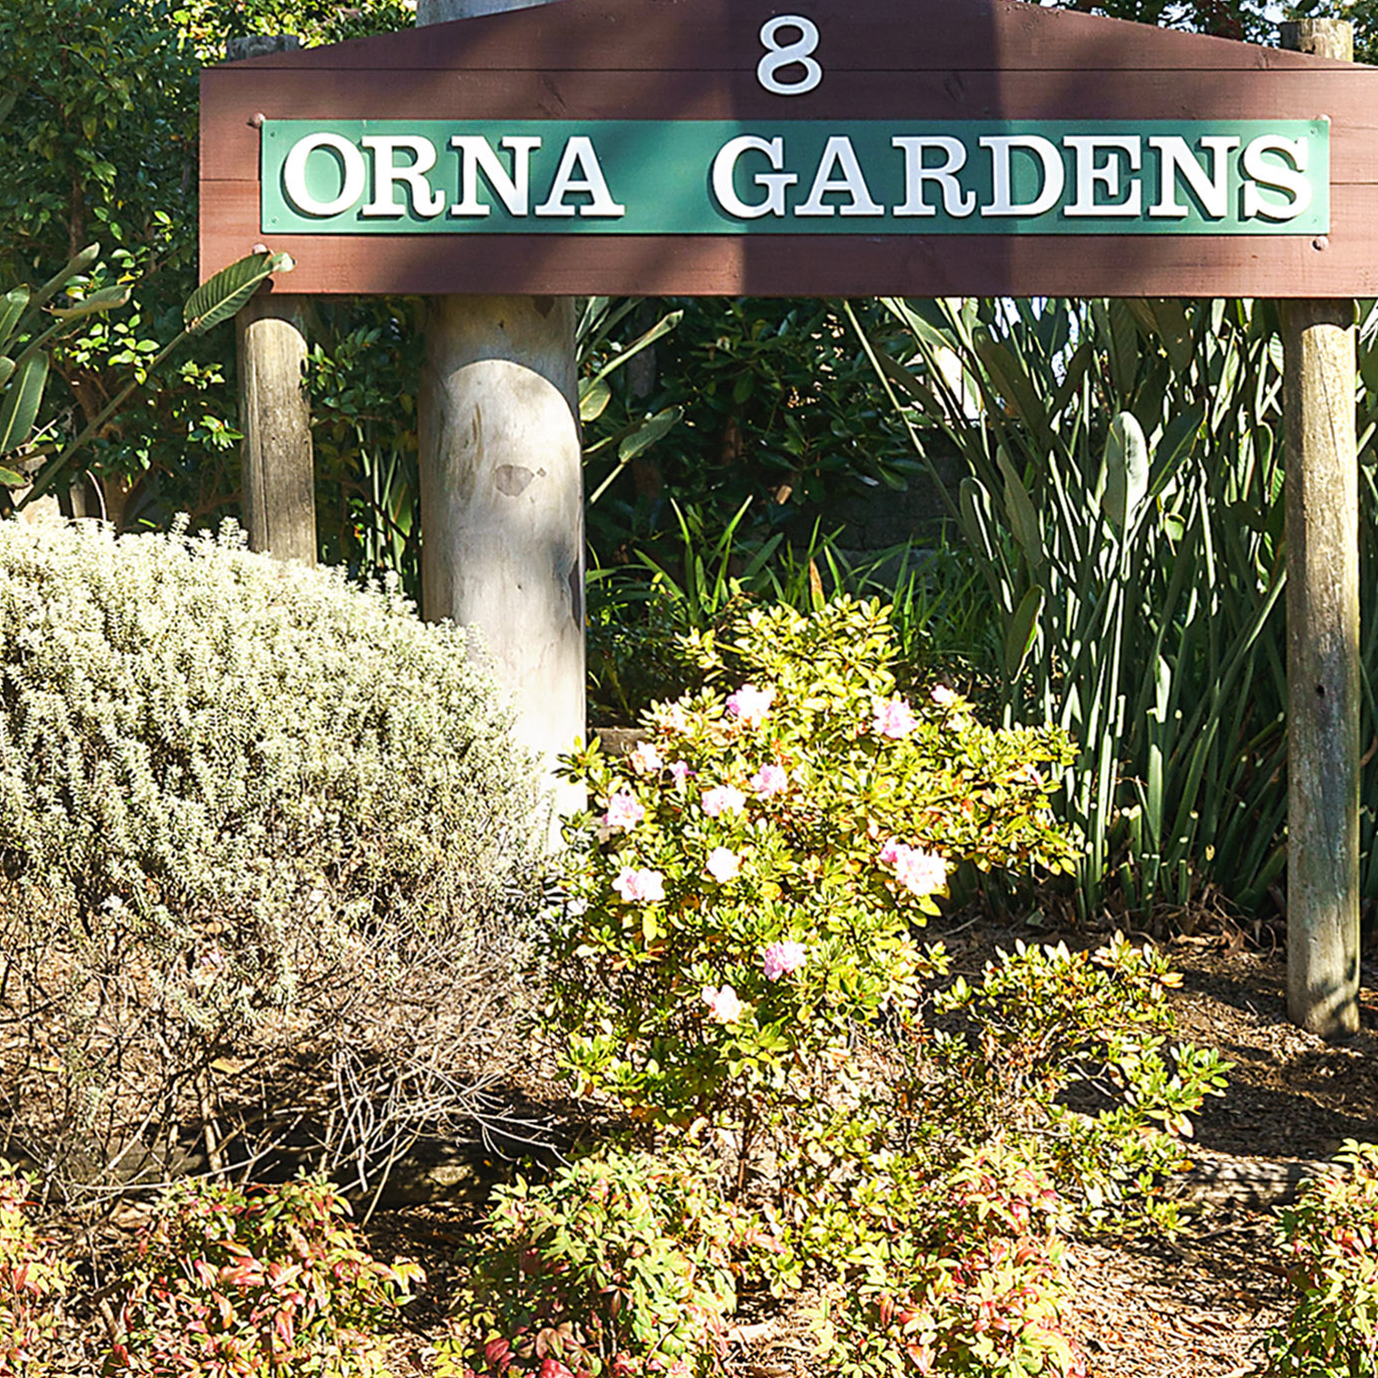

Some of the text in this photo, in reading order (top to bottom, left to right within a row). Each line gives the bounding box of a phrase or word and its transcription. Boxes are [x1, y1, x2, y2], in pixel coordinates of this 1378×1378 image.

[756, 15, 823, 96] 8
[281, 132, 1314, 221] ORNA GARDENS
